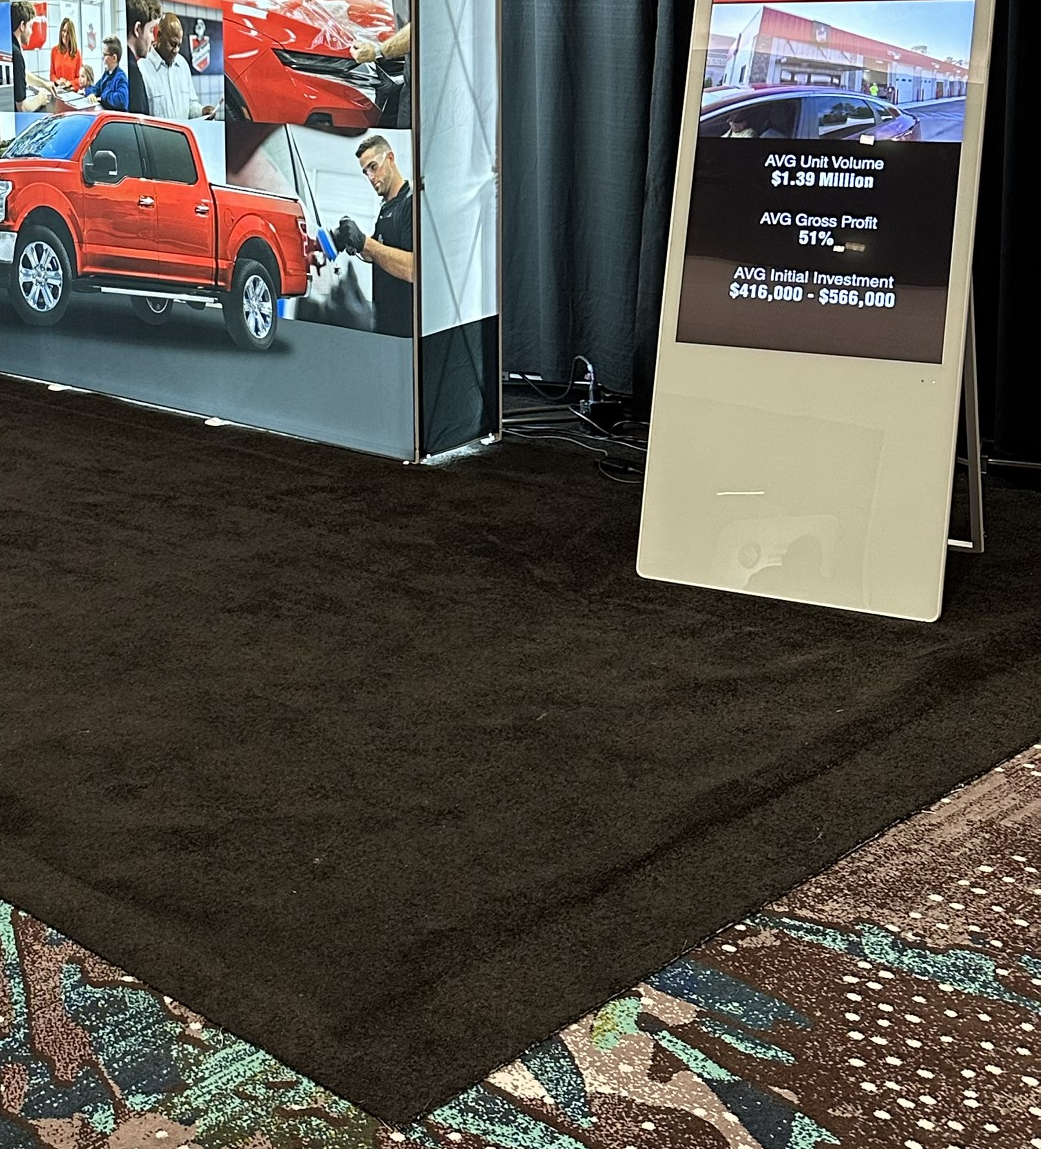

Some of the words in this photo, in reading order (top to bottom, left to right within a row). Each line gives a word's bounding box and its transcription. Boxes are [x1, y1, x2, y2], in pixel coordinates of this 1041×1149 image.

[764, 154, 796, 168] AVG
[800, 155, 829, 169] Unit
[832, 156, 884, 170] Volume
[771, 170, 815, 187] $1.39
[818, 172, 874, 188] Million
[760, 212, 792, 226] AVG
[795, 213, 838, 228] Gross
[841, 215, 878, 229] Profit
[798, 230, 835, 246] 51%
[733, 266, 766, 281] AVG
[770, 268, 809, 284] Initial
[813, 271, 894, 289] Investment
[729, 282, 803, 302] $416,000
[818, 288, 896, 308] $566,000
